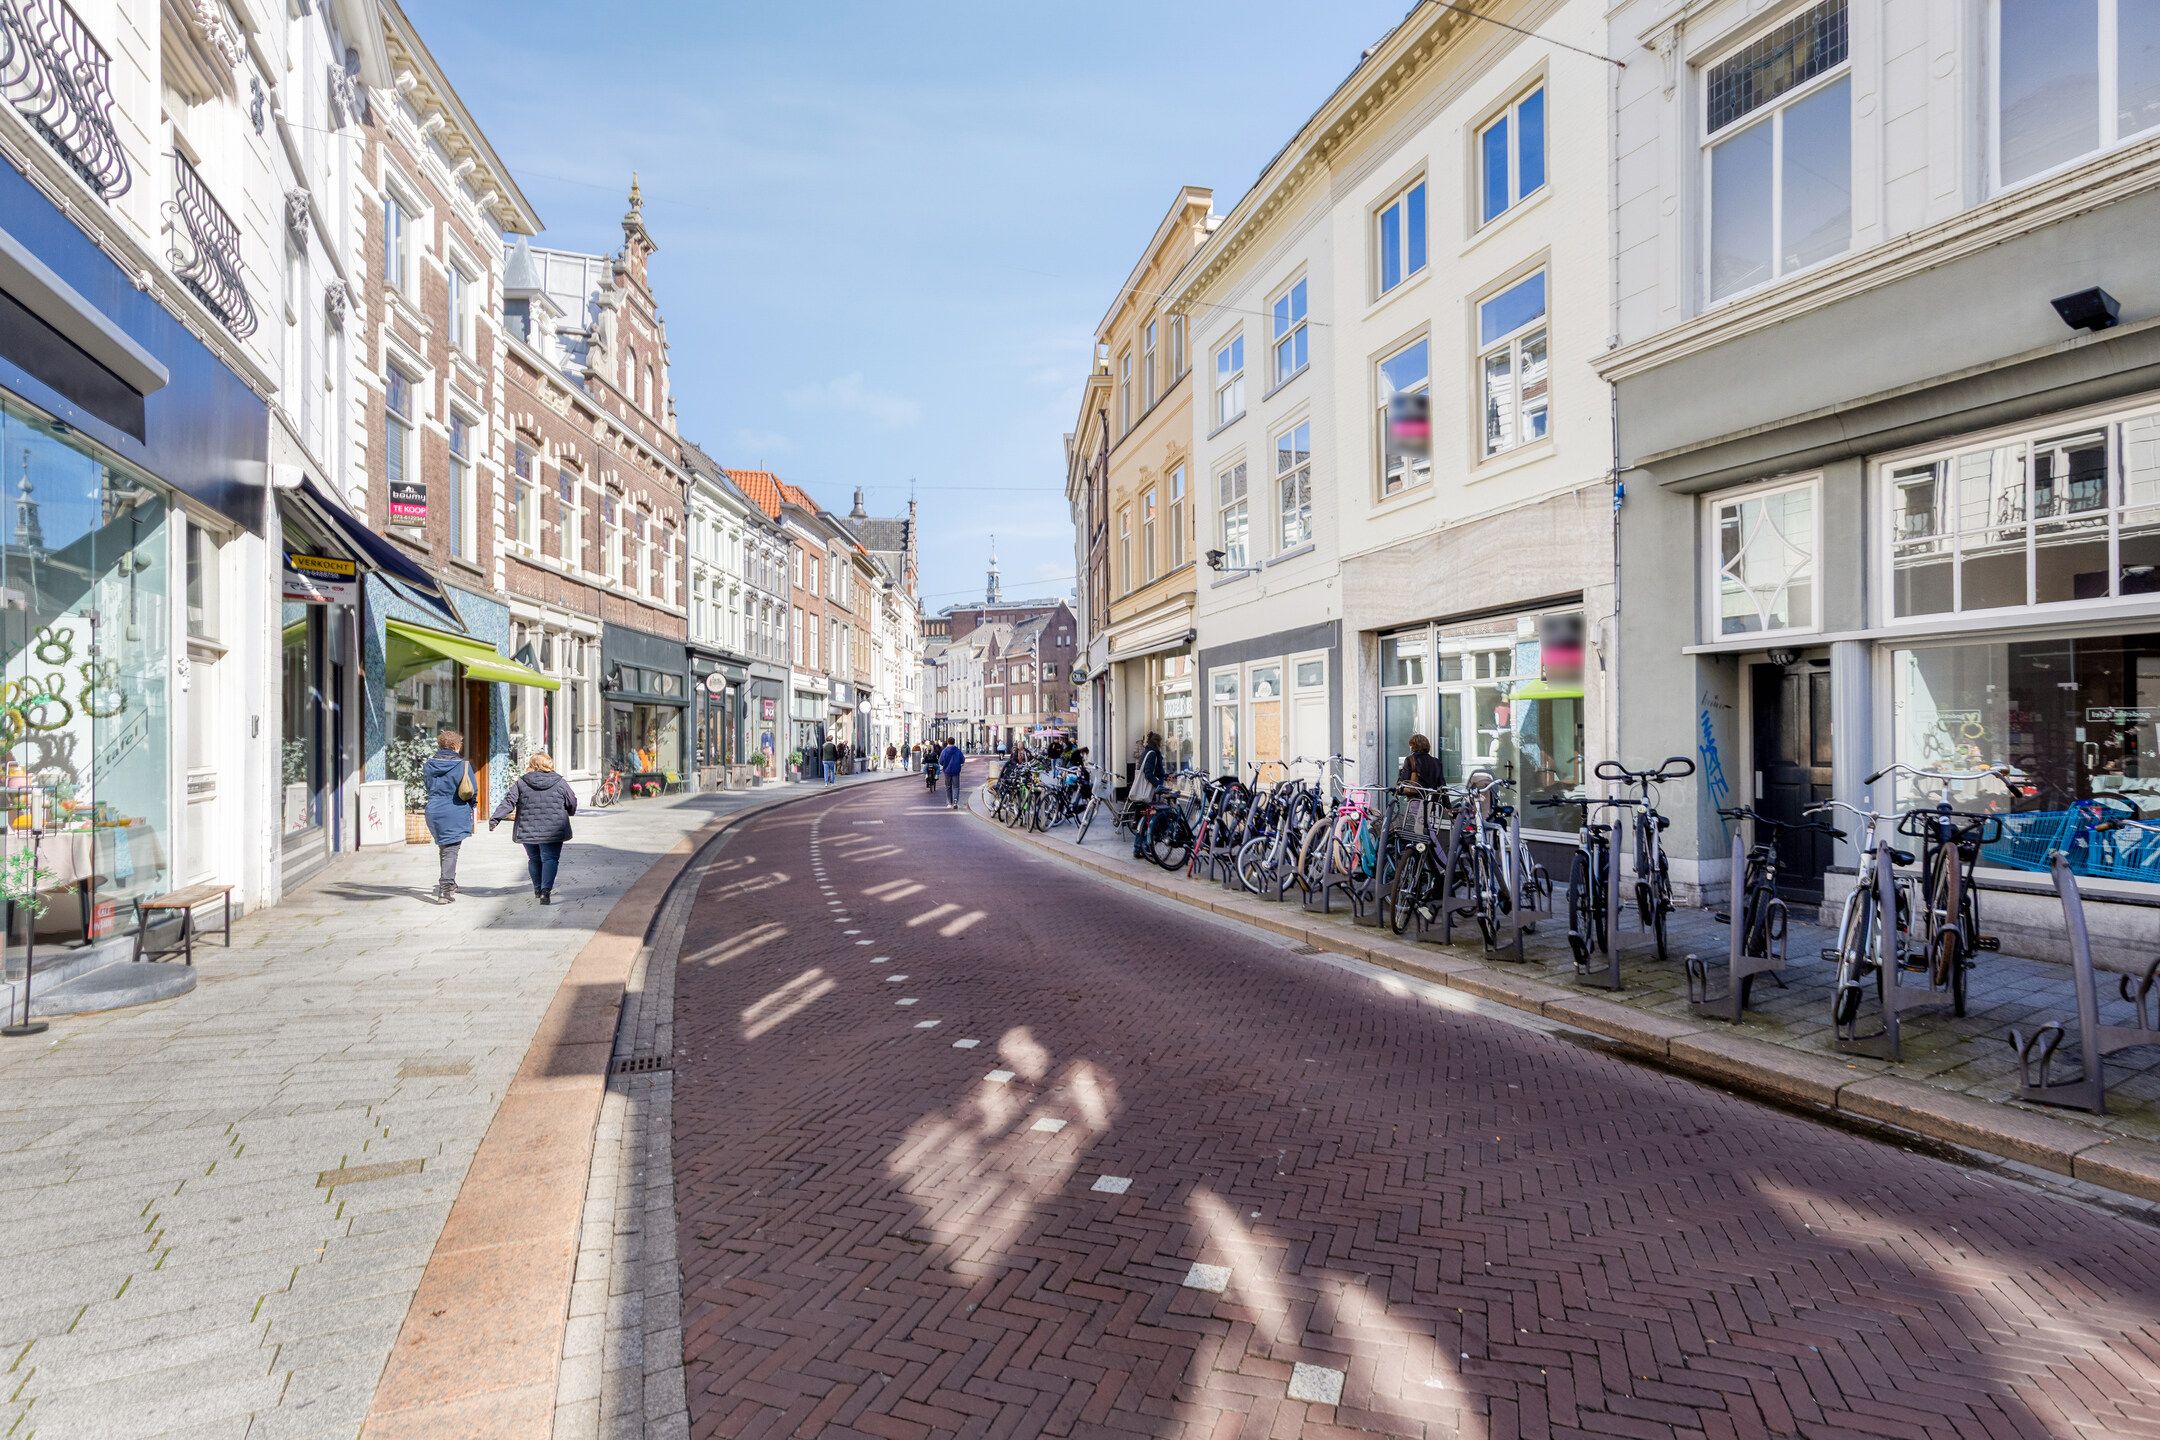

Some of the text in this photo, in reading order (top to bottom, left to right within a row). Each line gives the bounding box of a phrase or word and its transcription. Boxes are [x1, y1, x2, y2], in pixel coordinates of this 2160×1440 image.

[393, 504, 426, 514] TE KOOP
[298, 558, 348, 571] VERKOCHT
[106, 725, 138, 765] tafel
